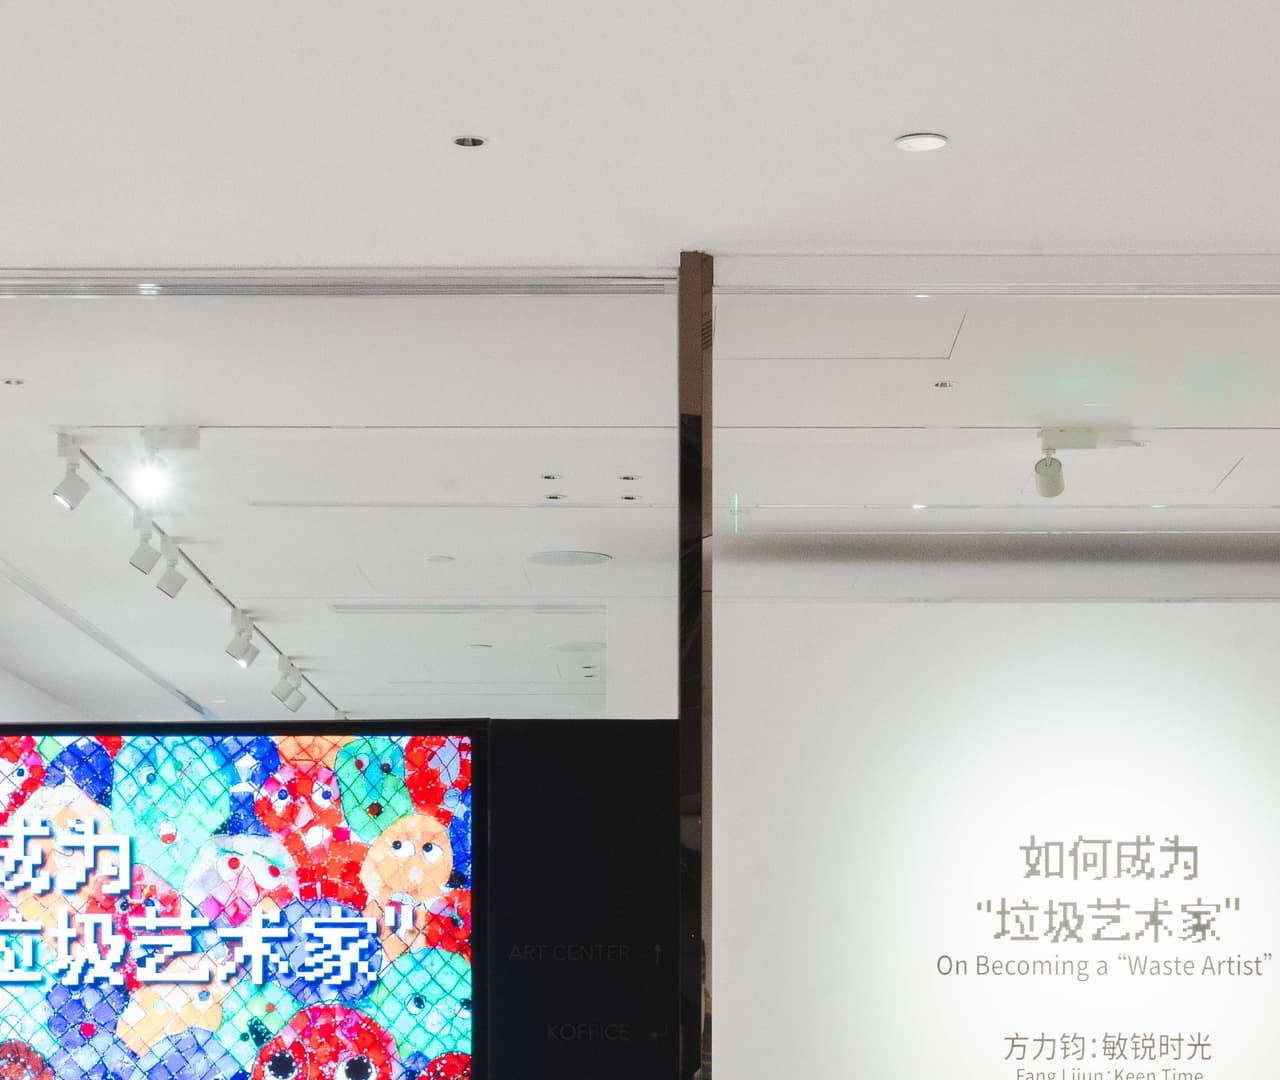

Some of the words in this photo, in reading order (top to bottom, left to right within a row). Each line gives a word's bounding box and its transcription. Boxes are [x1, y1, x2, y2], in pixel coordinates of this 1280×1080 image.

[1019, 834, 1199, 880] 如何成为
[976, 897, 1240, 943] “垃圾艺术家”
[508, 944, 546, 961] ART
[551, 944, 631, 961] CENTER
[936, 955, 968, 976] On
[976, 954, 1090, 982] Becoming
[1096, 959, 1108, 976] a
[1003, 1032, 1213, 1062] 方力钧：敏锐时光
